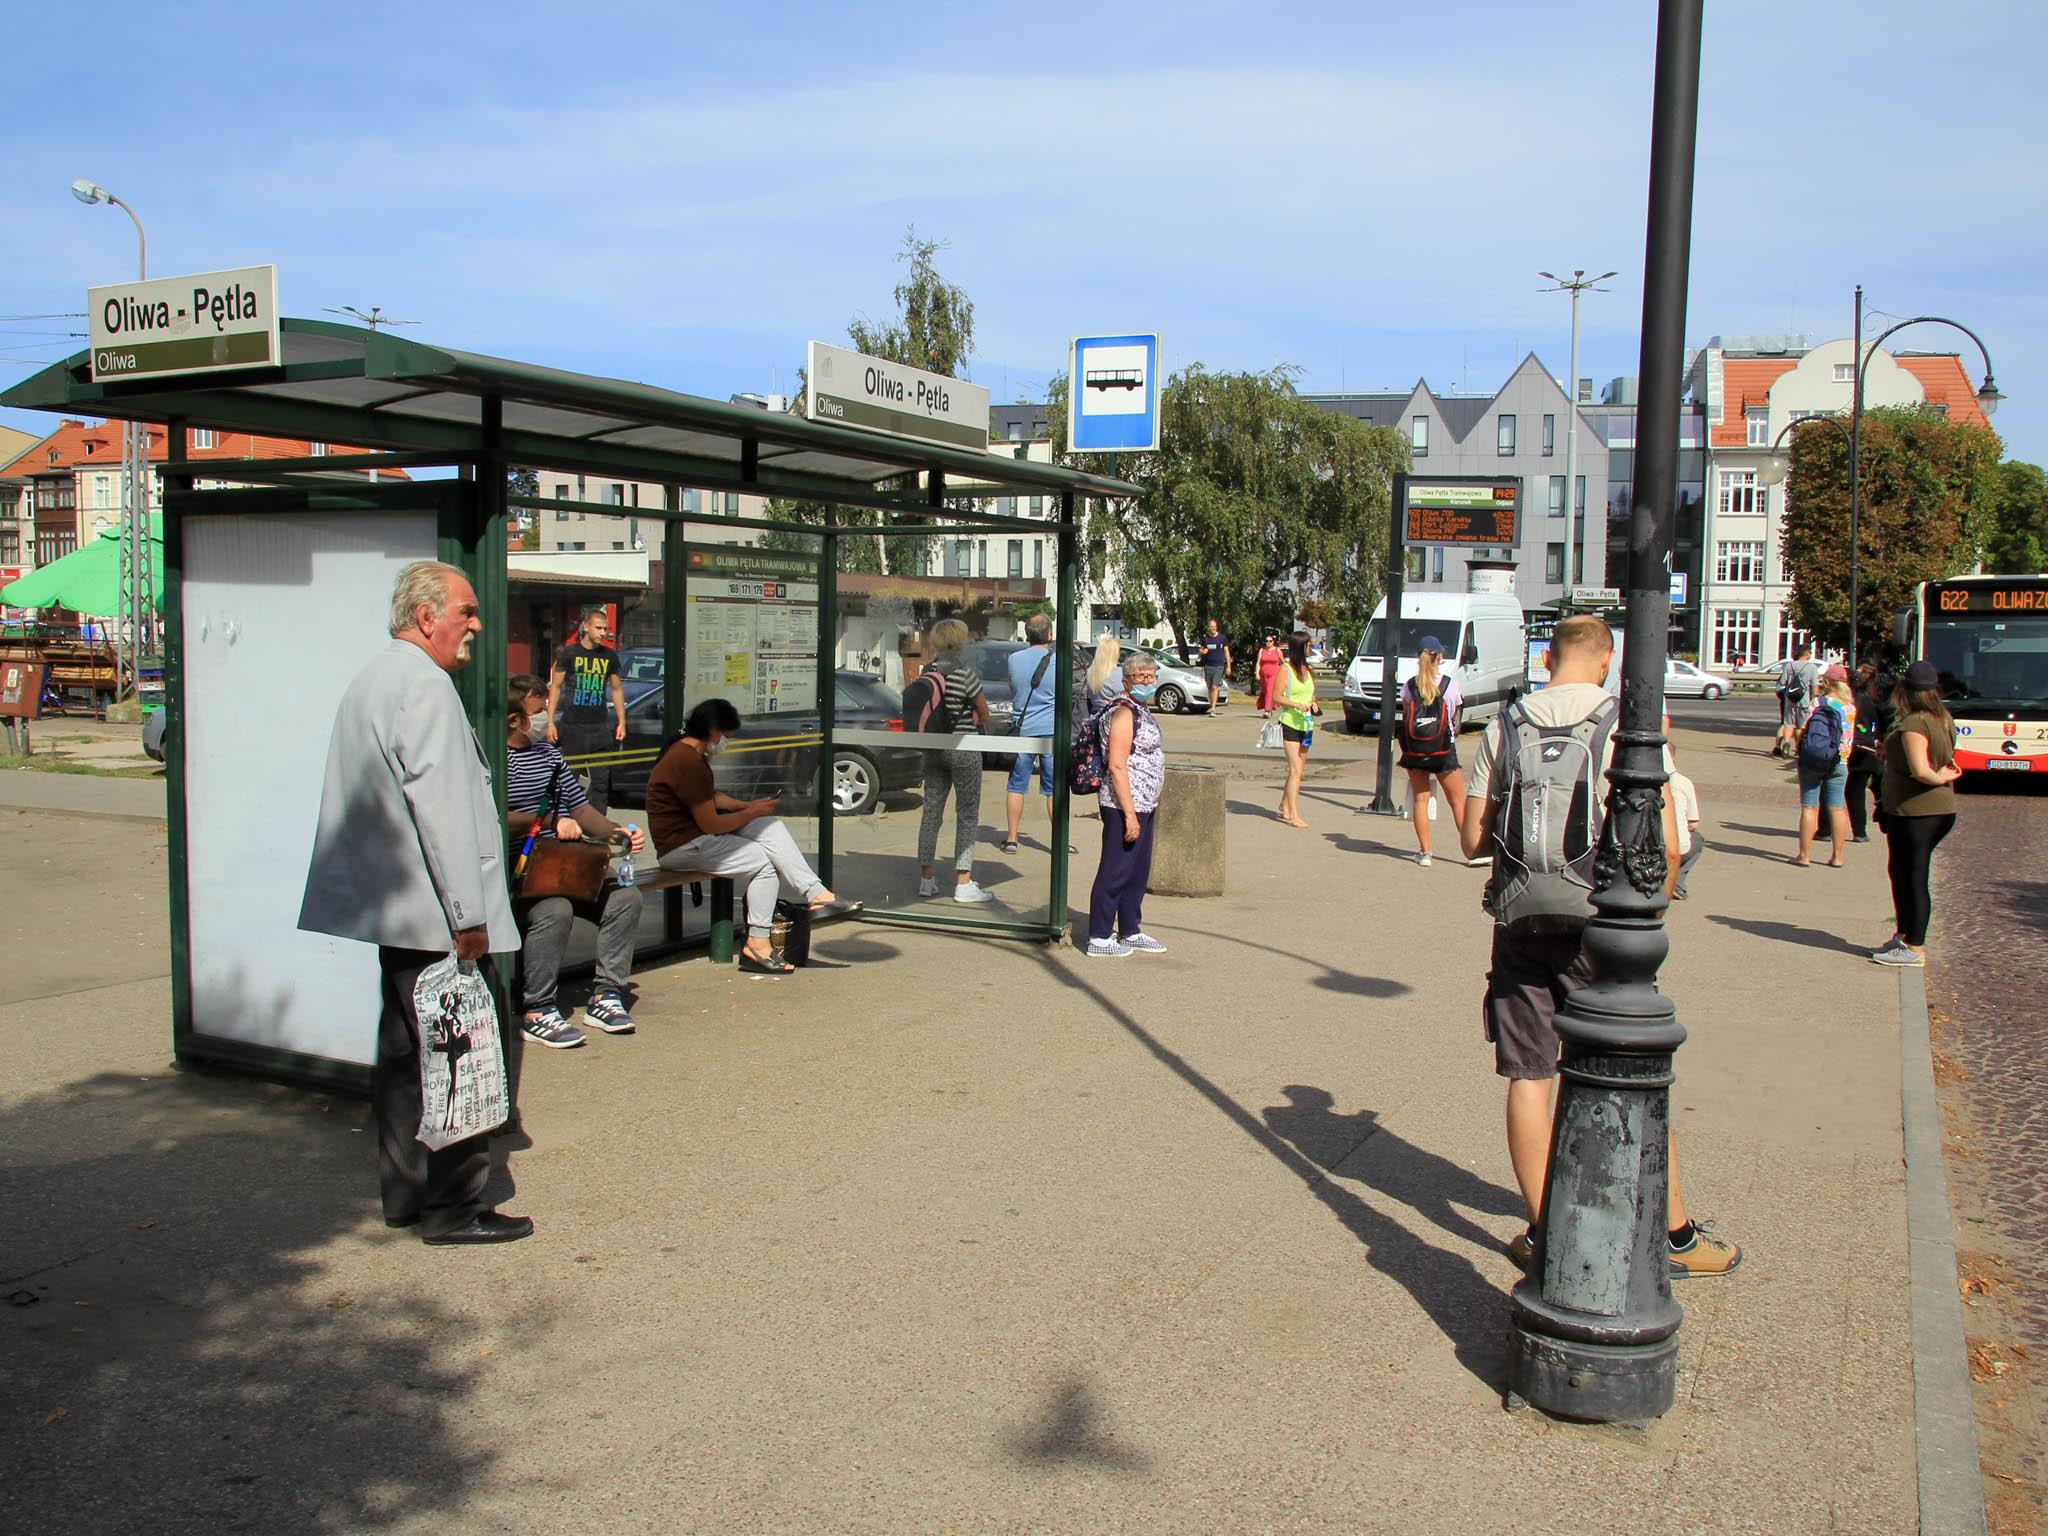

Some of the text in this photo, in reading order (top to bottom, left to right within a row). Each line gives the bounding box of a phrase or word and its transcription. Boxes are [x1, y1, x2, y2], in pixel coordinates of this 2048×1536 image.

[104, 296, 170, 335] Oliwa
[193, 284, 257, 332] Pętla
[97, 351, 137, 372] Oliwa
[864, 366, 904, 402] Oliwa
[916, 380, 950, 416] Pętla
[817, 396, 844, 418] Oliwa
[716, 555, 739, 567] OLIWA
[739, 557, 761, 571] PĘTLA
[1576, 590, 1595, 598] Oliwa
[1600, 590, 1616, 599] Pętla
[1941, 590, 1969, 611] 622
[1993, 591, 2033, 609] OLIWA
[575, 656, 609, 674] PLAY
[575, 673, 606, 691] THAT
[573, 689, 605, 706] BEAT
